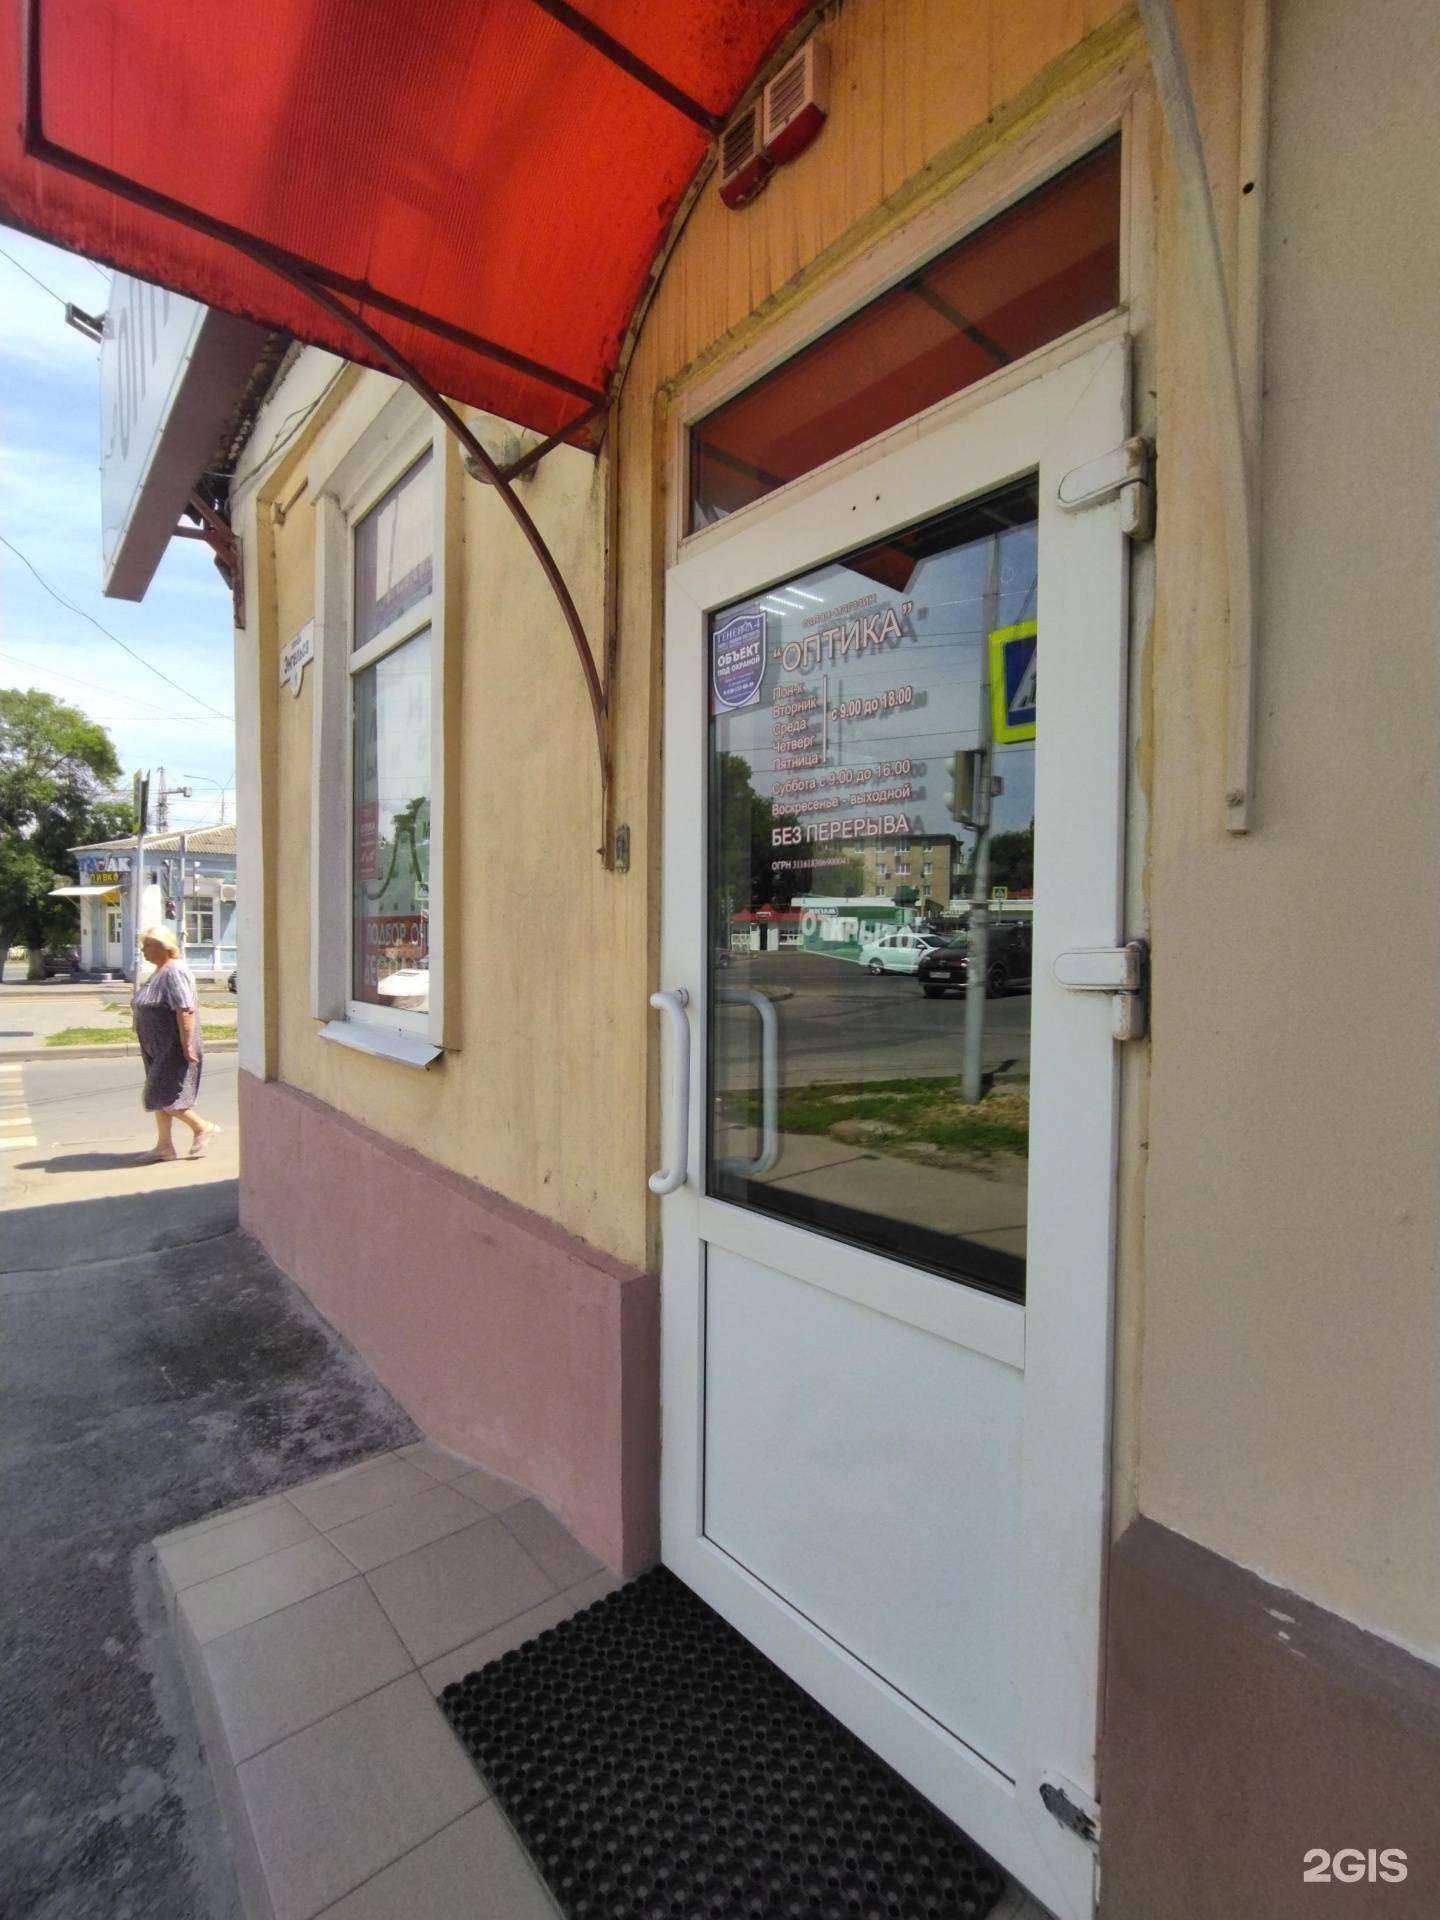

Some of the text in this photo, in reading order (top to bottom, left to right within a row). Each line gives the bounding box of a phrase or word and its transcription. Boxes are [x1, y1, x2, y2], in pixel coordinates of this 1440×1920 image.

[717, 643, 760, 667] ОБЪЕКТ
[773, 696, 817, 718] Вторник
[864, 699, 879, 715] до
[773, 720, 807, 737] Среда
[773, 735, 816, 753] Четверг
[774, 754, 818, 770] Пятница
[772, 778, 816, 797] Суббота
[856, 769, 872, 782] до
[772, 798, 839, 816] Воскресенье
[850, 784, 911, 805] выходной
[772, 814, 909, 846] БЕЗ ПЕРЕРЫВА
[772, 860, 791, 870] ОГРН
